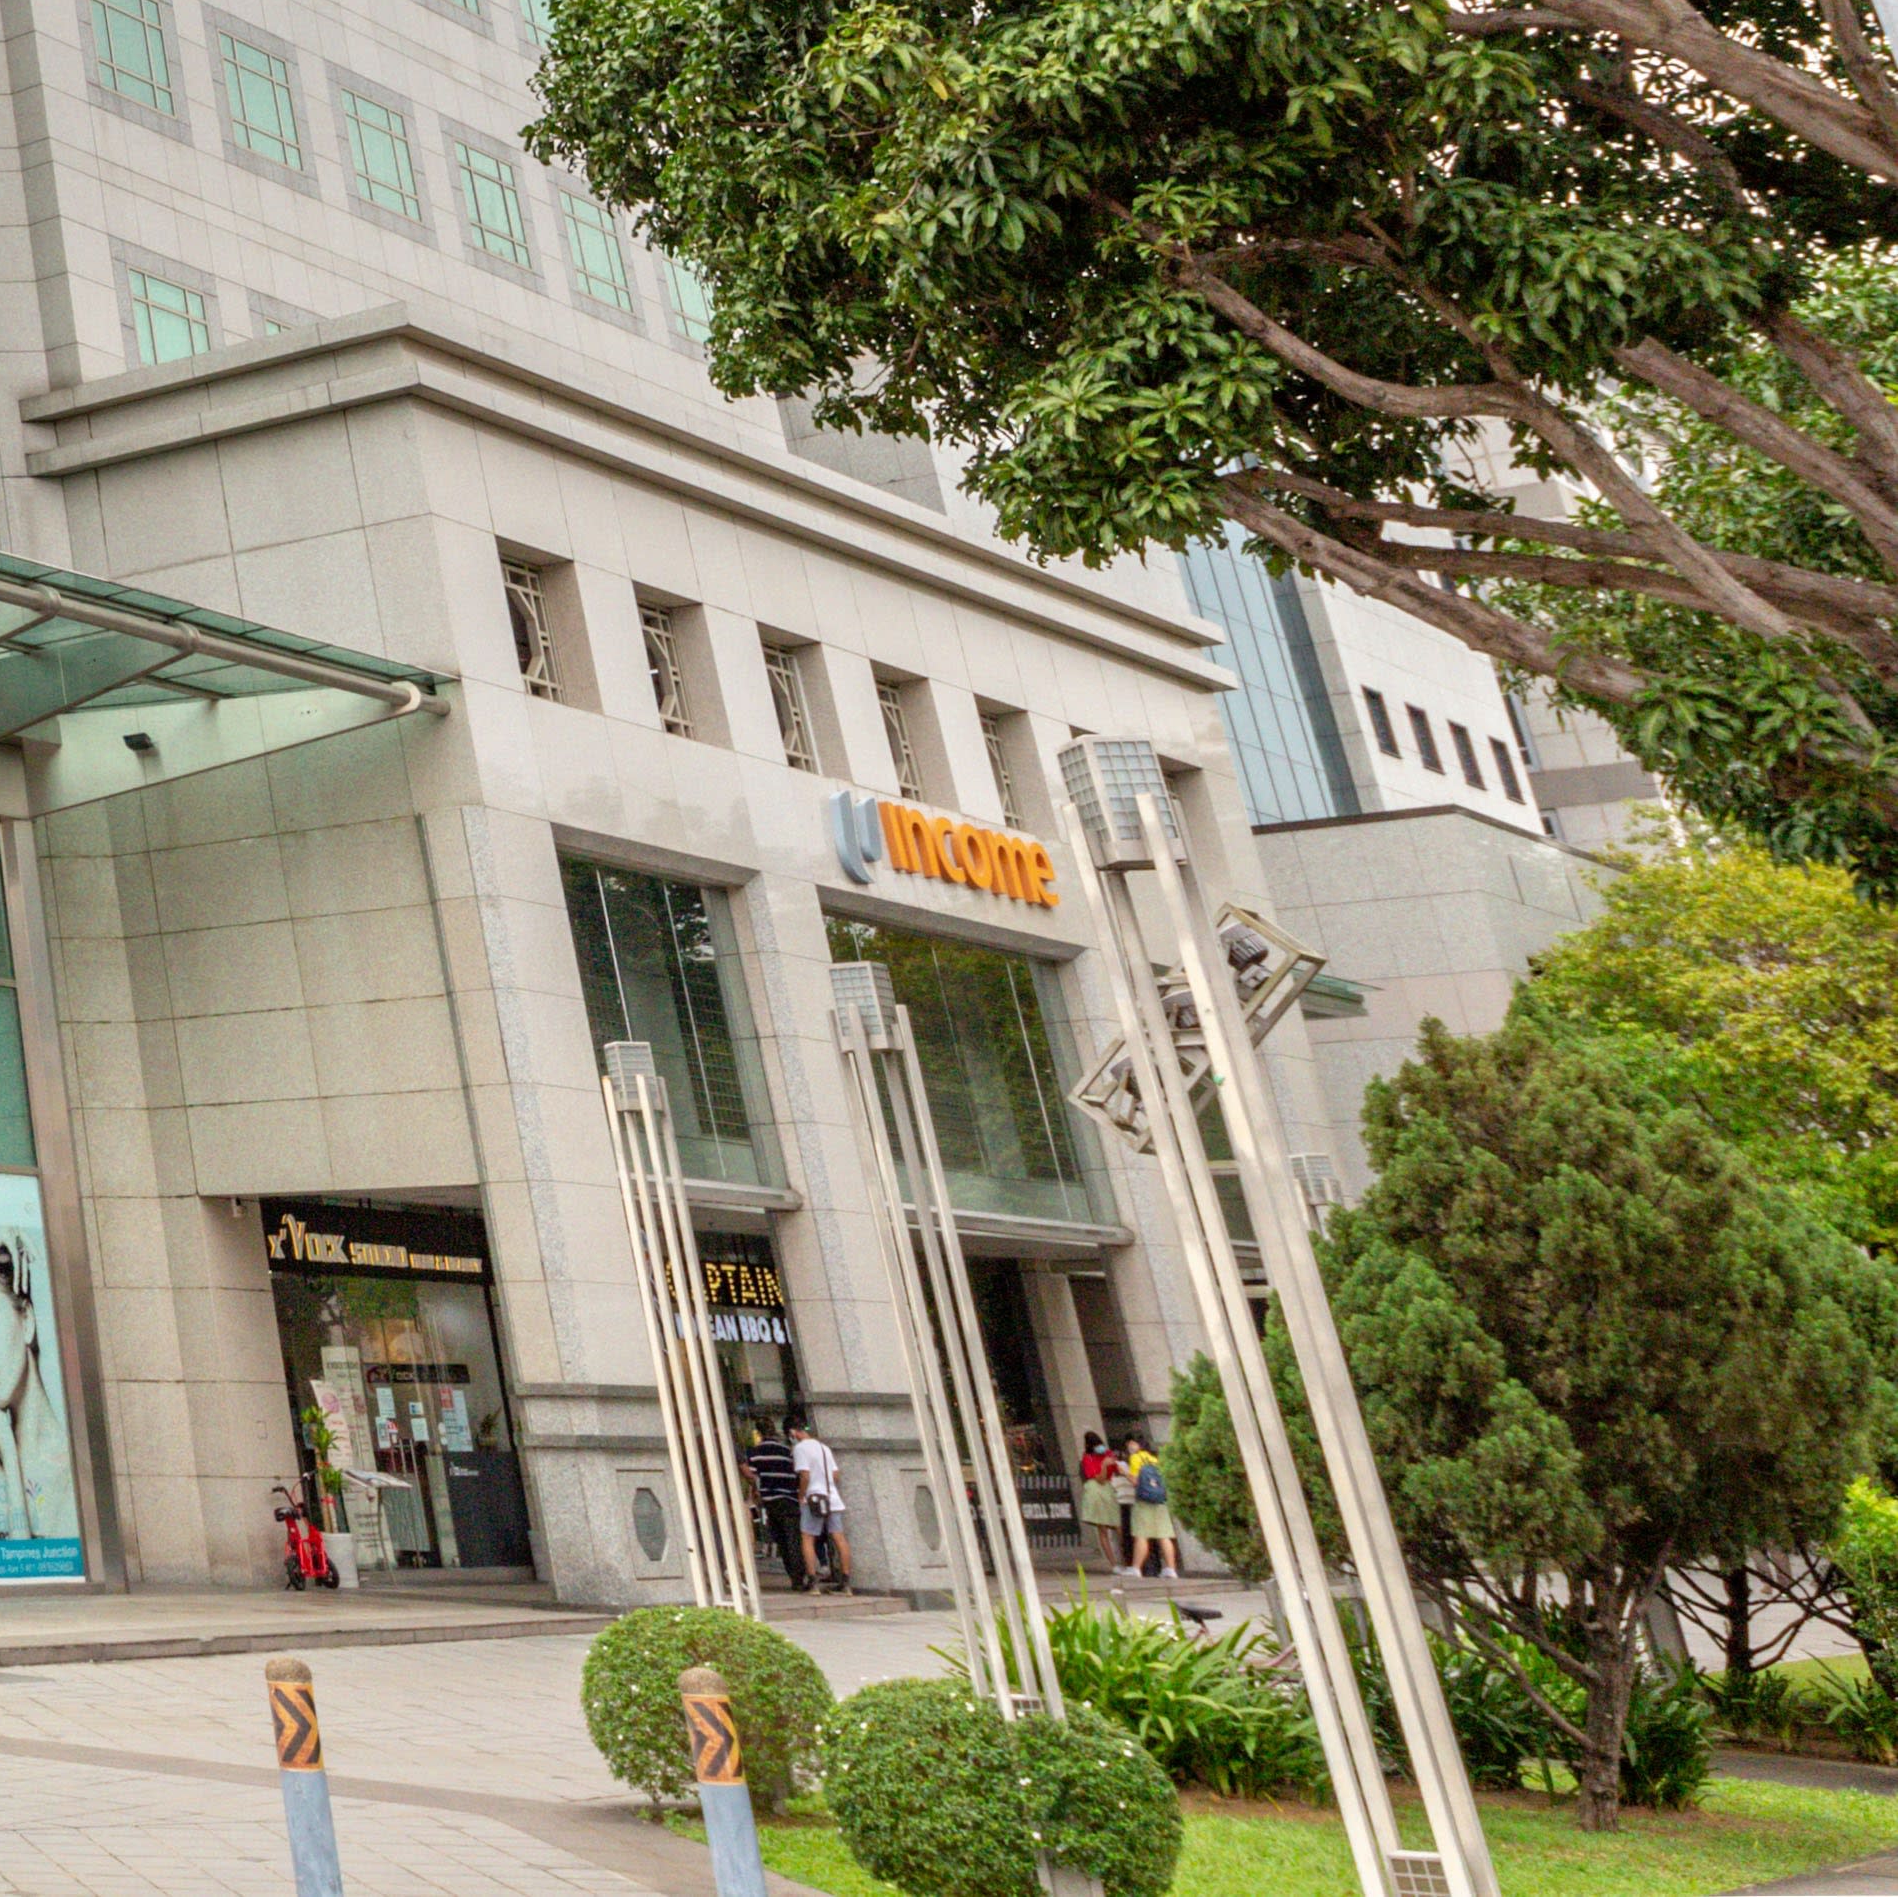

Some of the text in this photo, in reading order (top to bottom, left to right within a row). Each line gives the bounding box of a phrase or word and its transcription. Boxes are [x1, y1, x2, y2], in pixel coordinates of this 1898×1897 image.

[877, 801, 1060, 909] income
[665, 1260, 784, 1306] CPTAIN
[738, 1314, 772, 1343] BBQ
